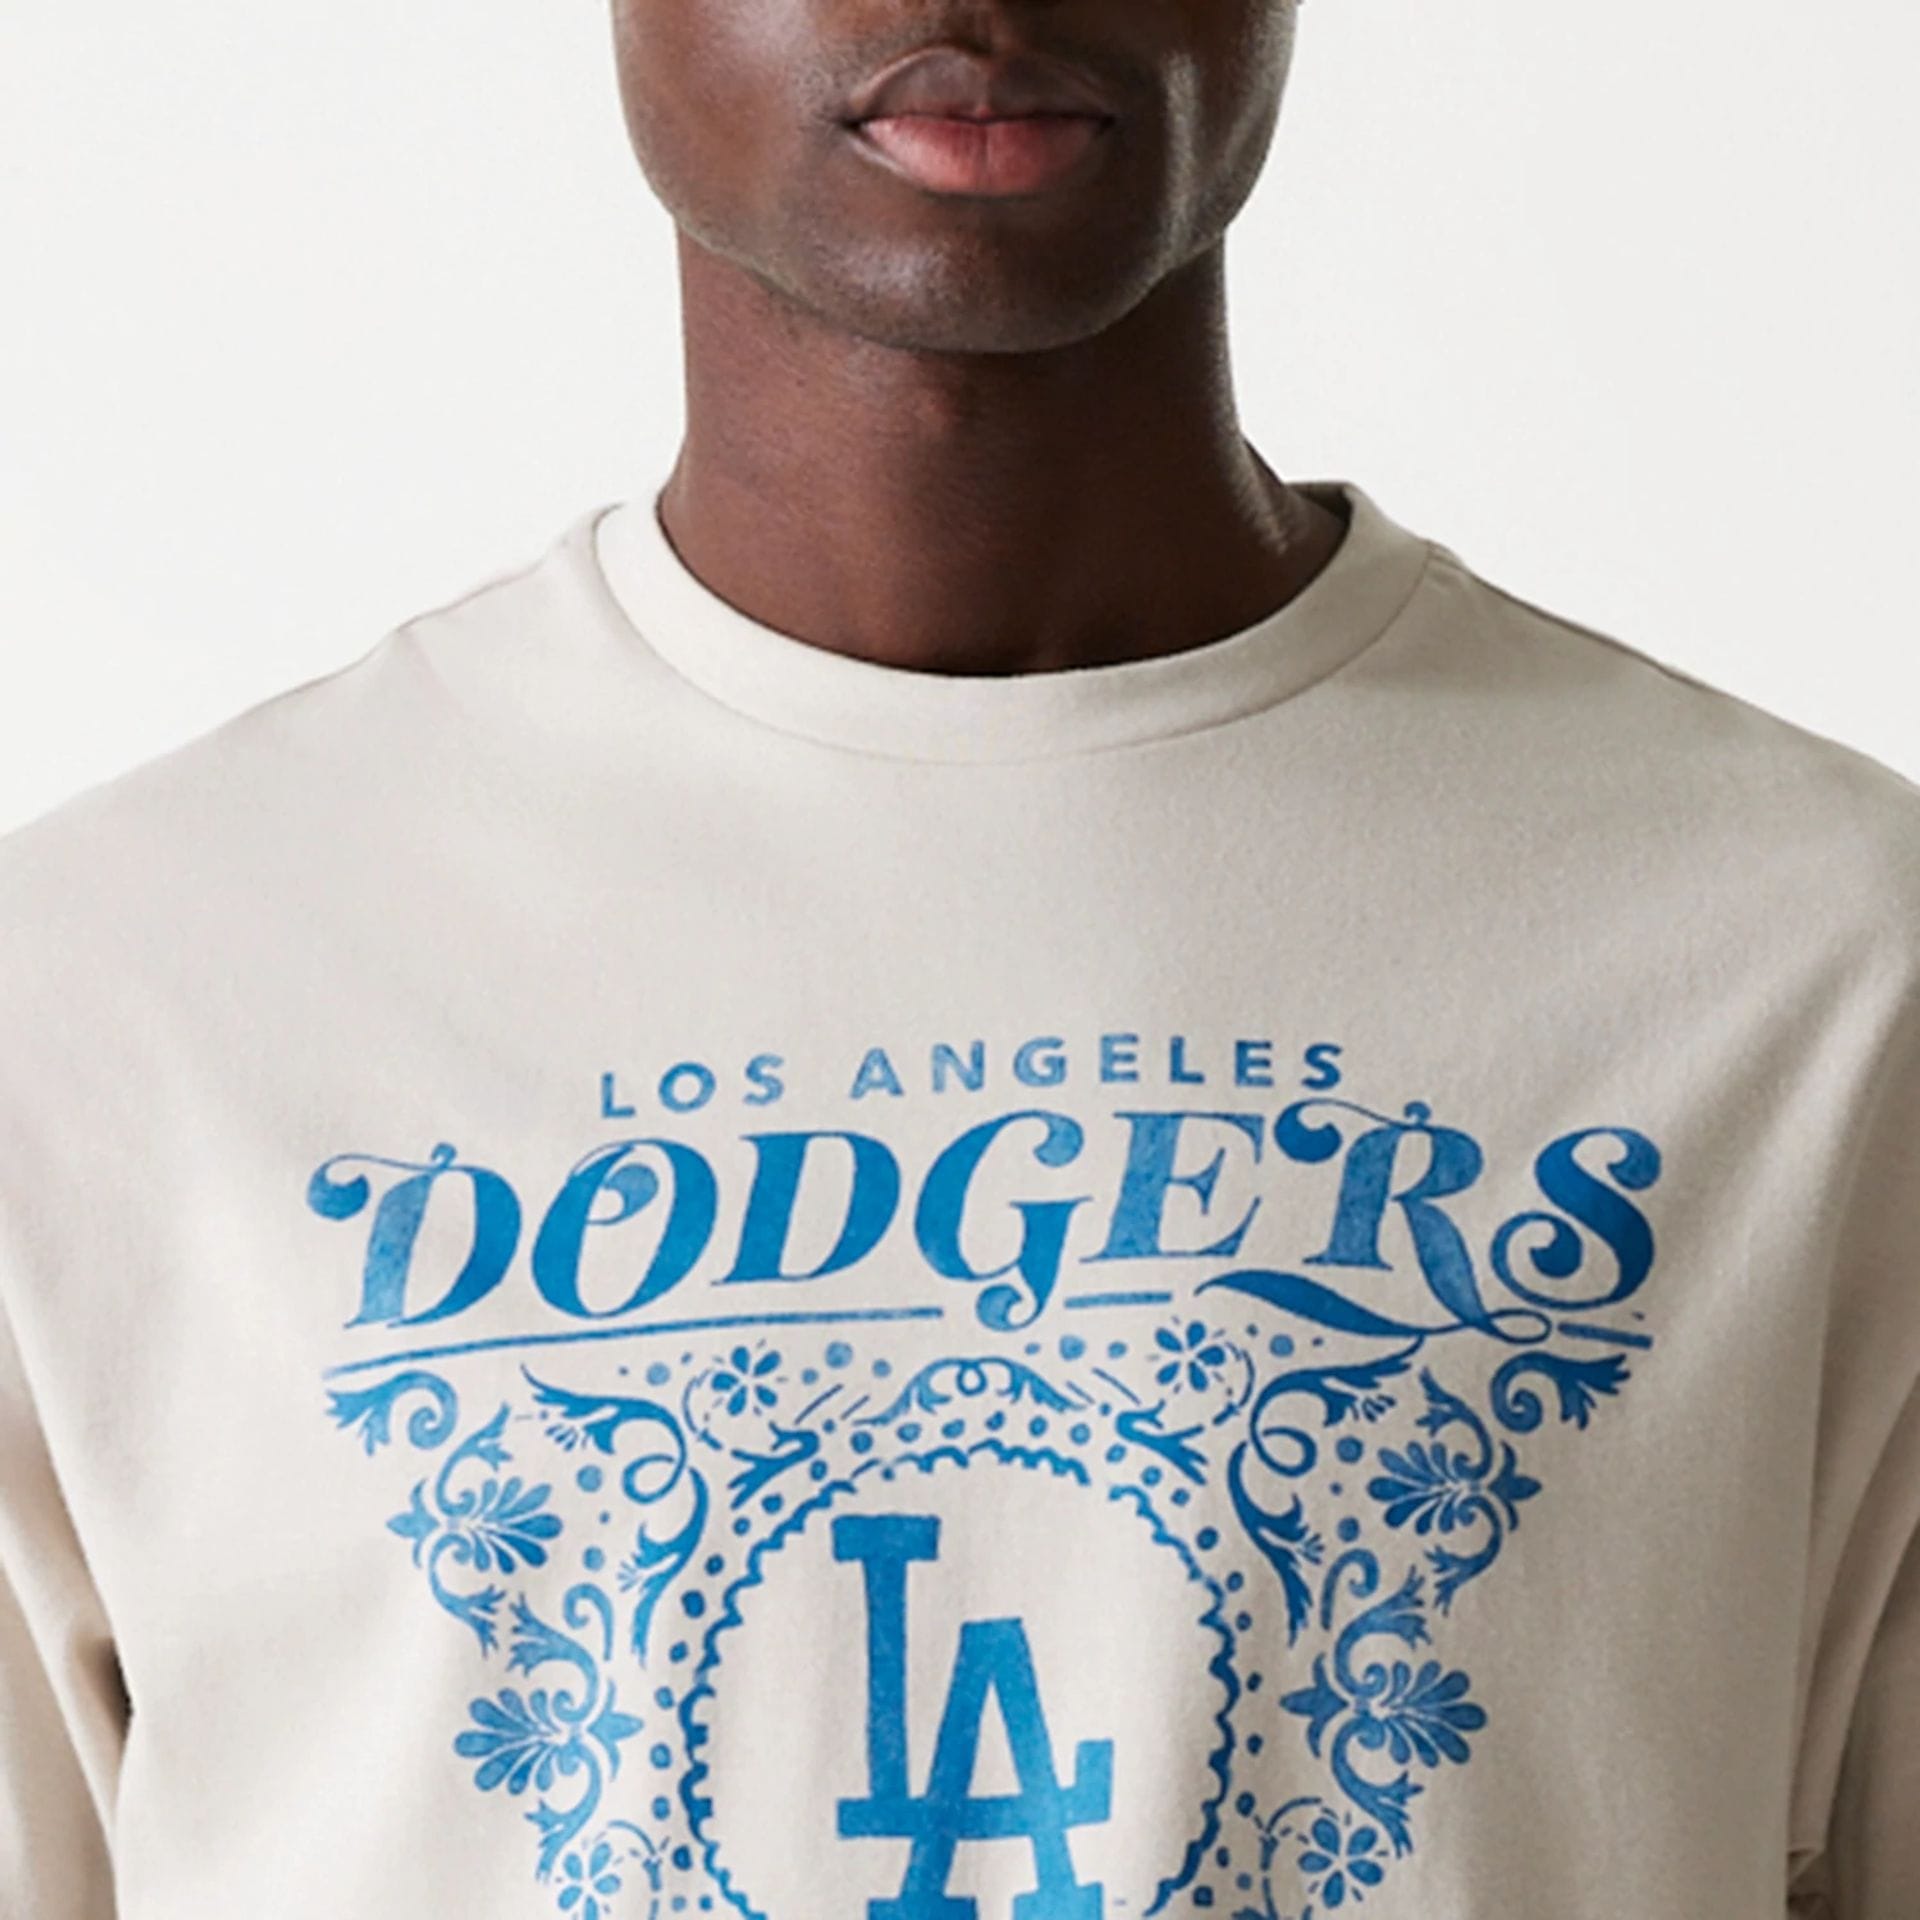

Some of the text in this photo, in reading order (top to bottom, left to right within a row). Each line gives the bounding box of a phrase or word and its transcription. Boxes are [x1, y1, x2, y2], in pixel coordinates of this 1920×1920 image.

[600, 1033, 1342, 1120] LOS ANGELES
[306, 1097, 1662, 1346] DODGERS
[829, 1512, 1116, 1920] LA
